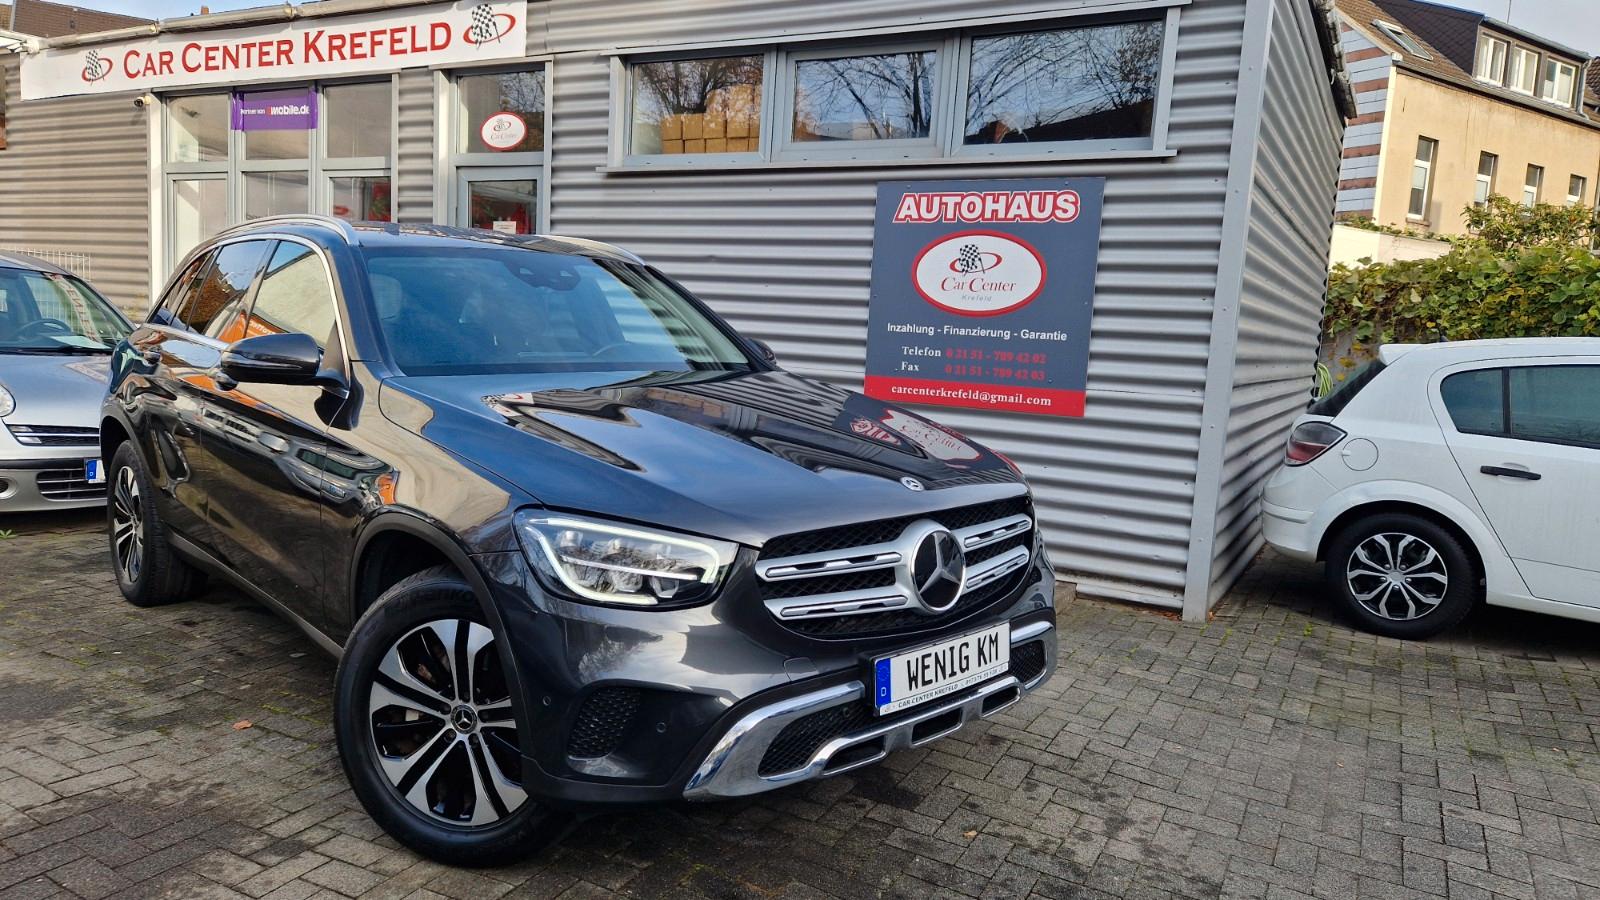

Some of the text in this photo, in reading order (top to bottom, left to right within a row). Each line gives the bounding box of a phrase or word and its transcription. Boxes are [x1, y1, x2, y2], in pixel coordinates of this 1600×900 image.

[123, 22, 453, 79] CAR CENTER KREFELD
[892, 190, 1081, 224] AUTOHAUS
[941, 276, 1017, 293] Car Center
[961, 294, 993, 302] Krefeld
[887, 322, 934, 336] Inzahlung
[943, 325, 1011, 340] Finanzierung
[1020, 328, 1068, 342] Garantie
[901, 345, 942, 357] Telefon
[901, 361, 920, 372] Fax
[891, 385, 1052, 407] carcenterkrefeld@gmail.com
[906, 631, 999, 692] WENIG KM
[880, 686, 887, 697] D
[898, 698, 911, 708] CAR
[911, 692, 934, 704] CENTER
